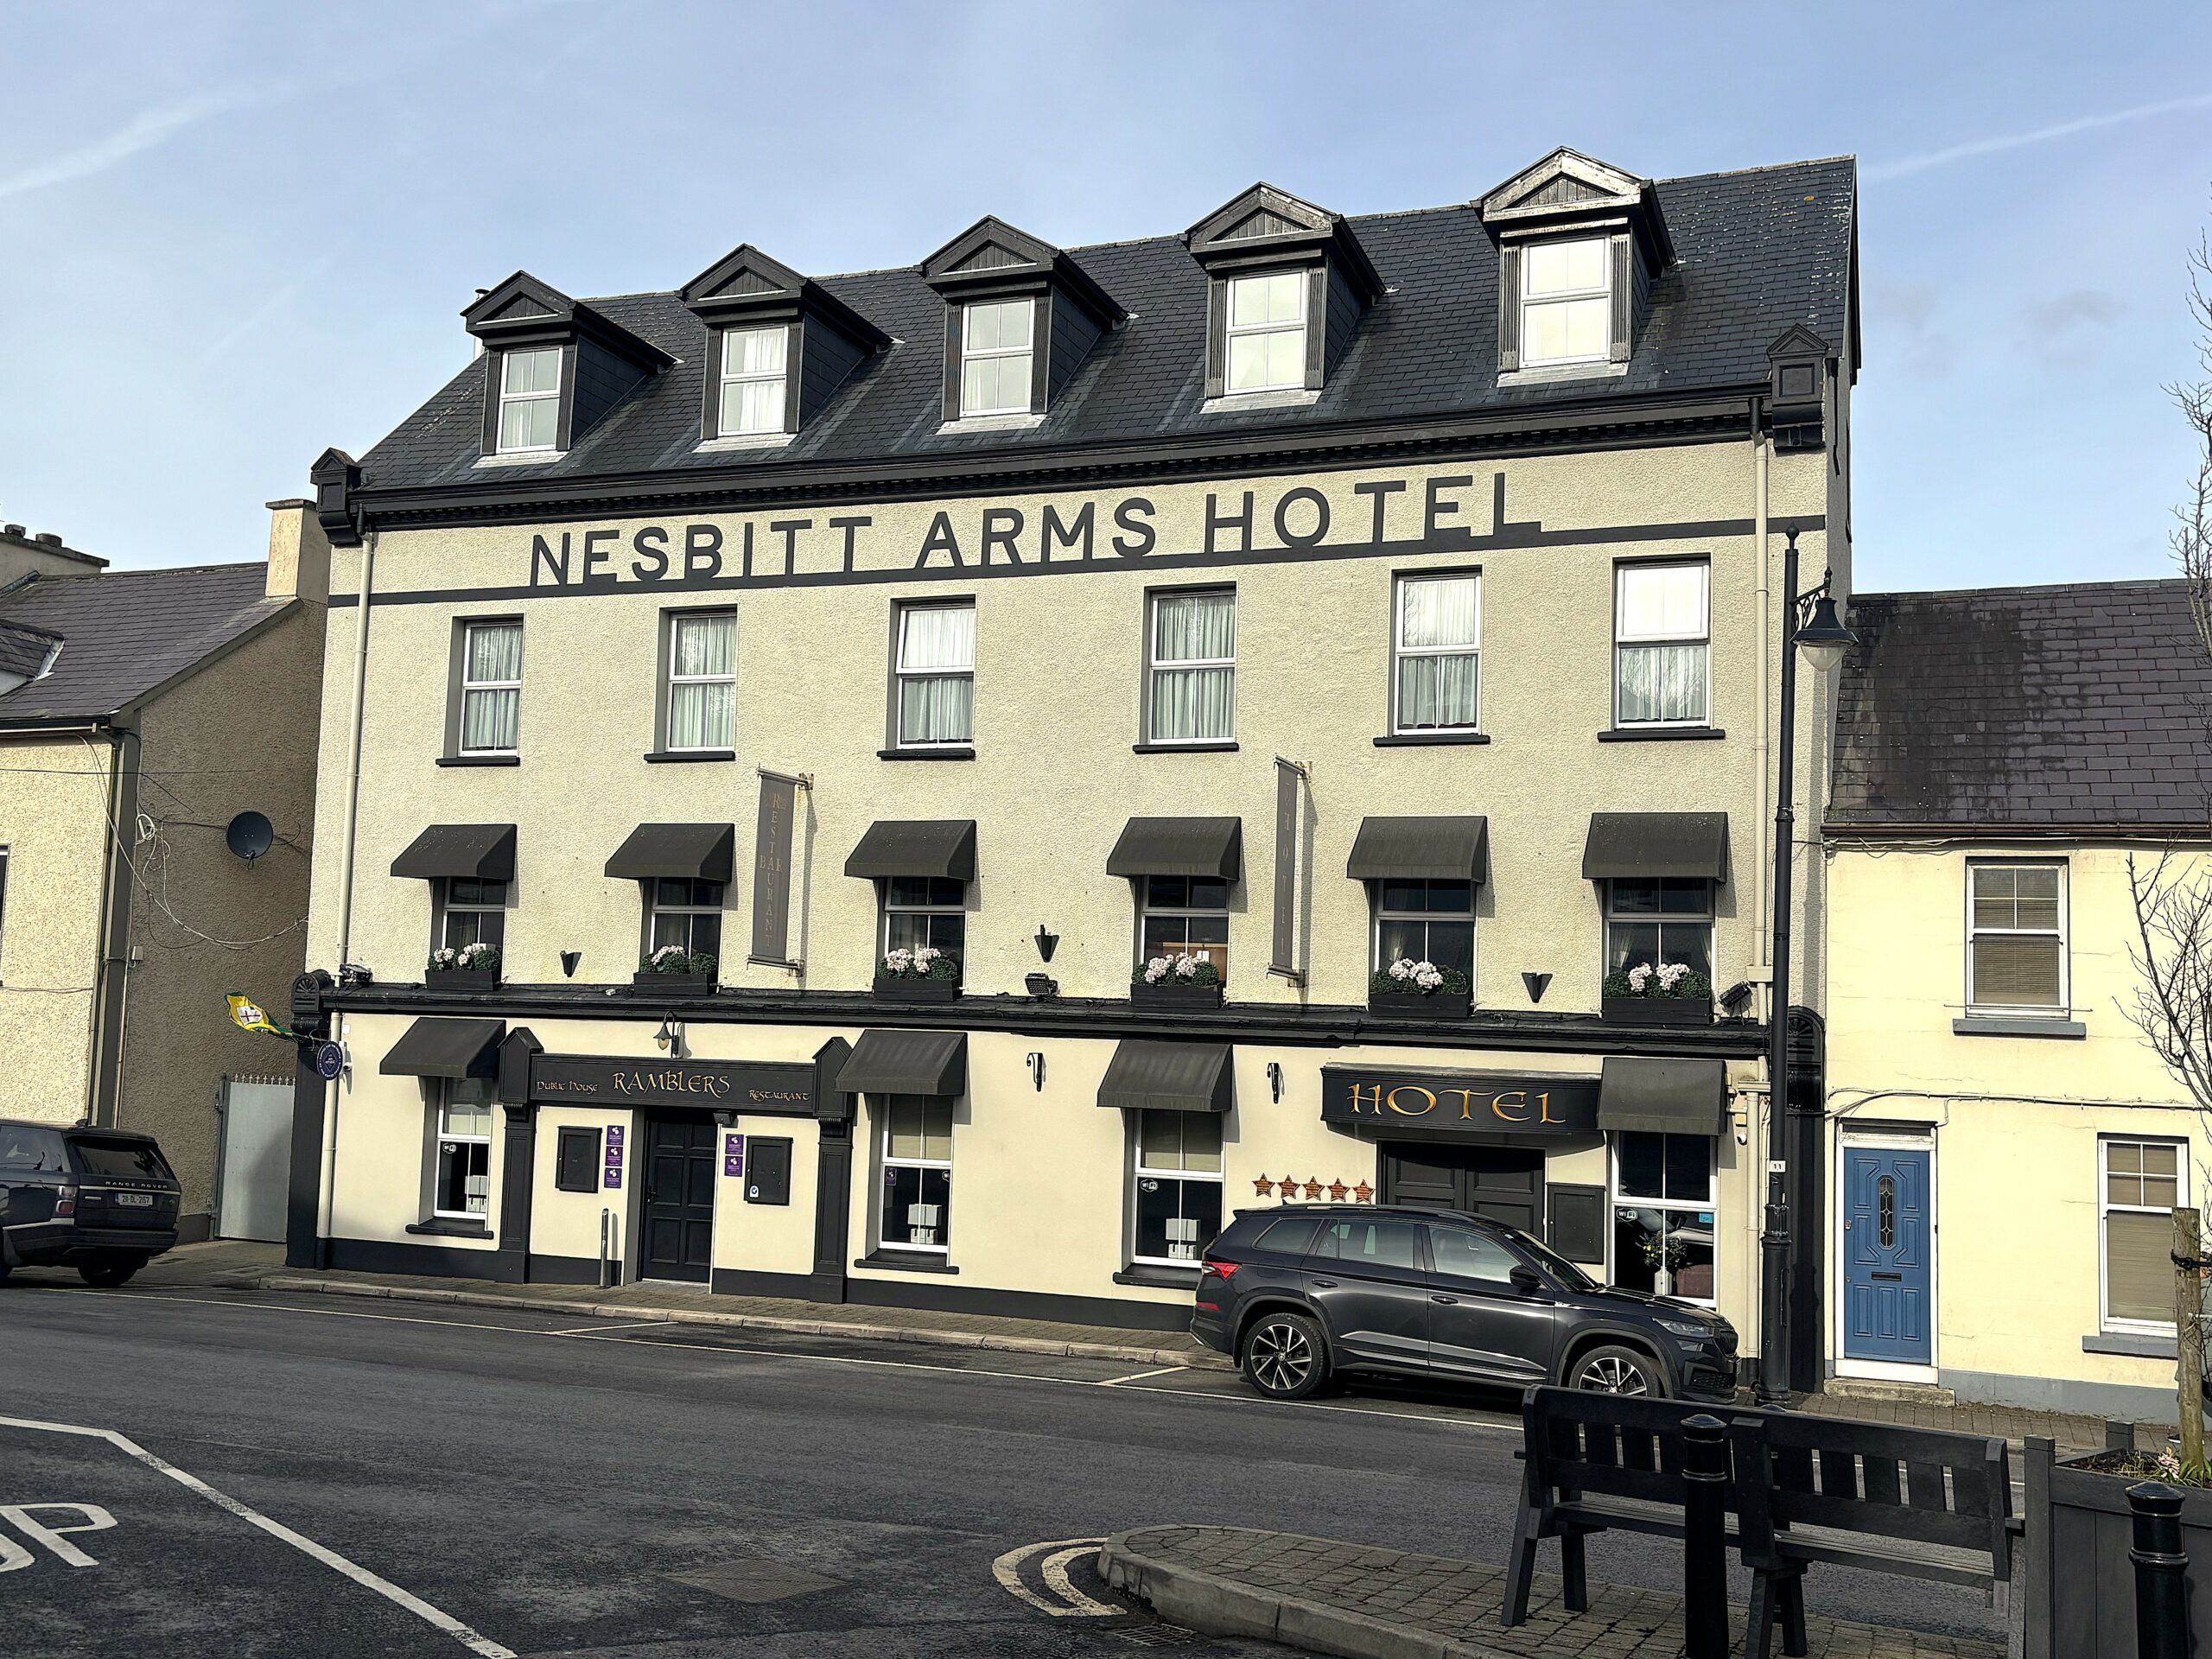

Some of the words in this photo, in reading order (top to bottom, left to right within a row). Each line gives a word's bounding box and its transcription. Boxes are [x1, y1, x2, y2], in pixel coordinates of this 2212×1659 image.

[530, 515, 872, 587] NESBITT
[915, 497, 1156, 568] ARMS
[1205, 473, 1541, 552] HOTEL
[612, 1070, 731, 1098] RAMBLERS
[1347, 1083, 1567, 1124] HOTEL
